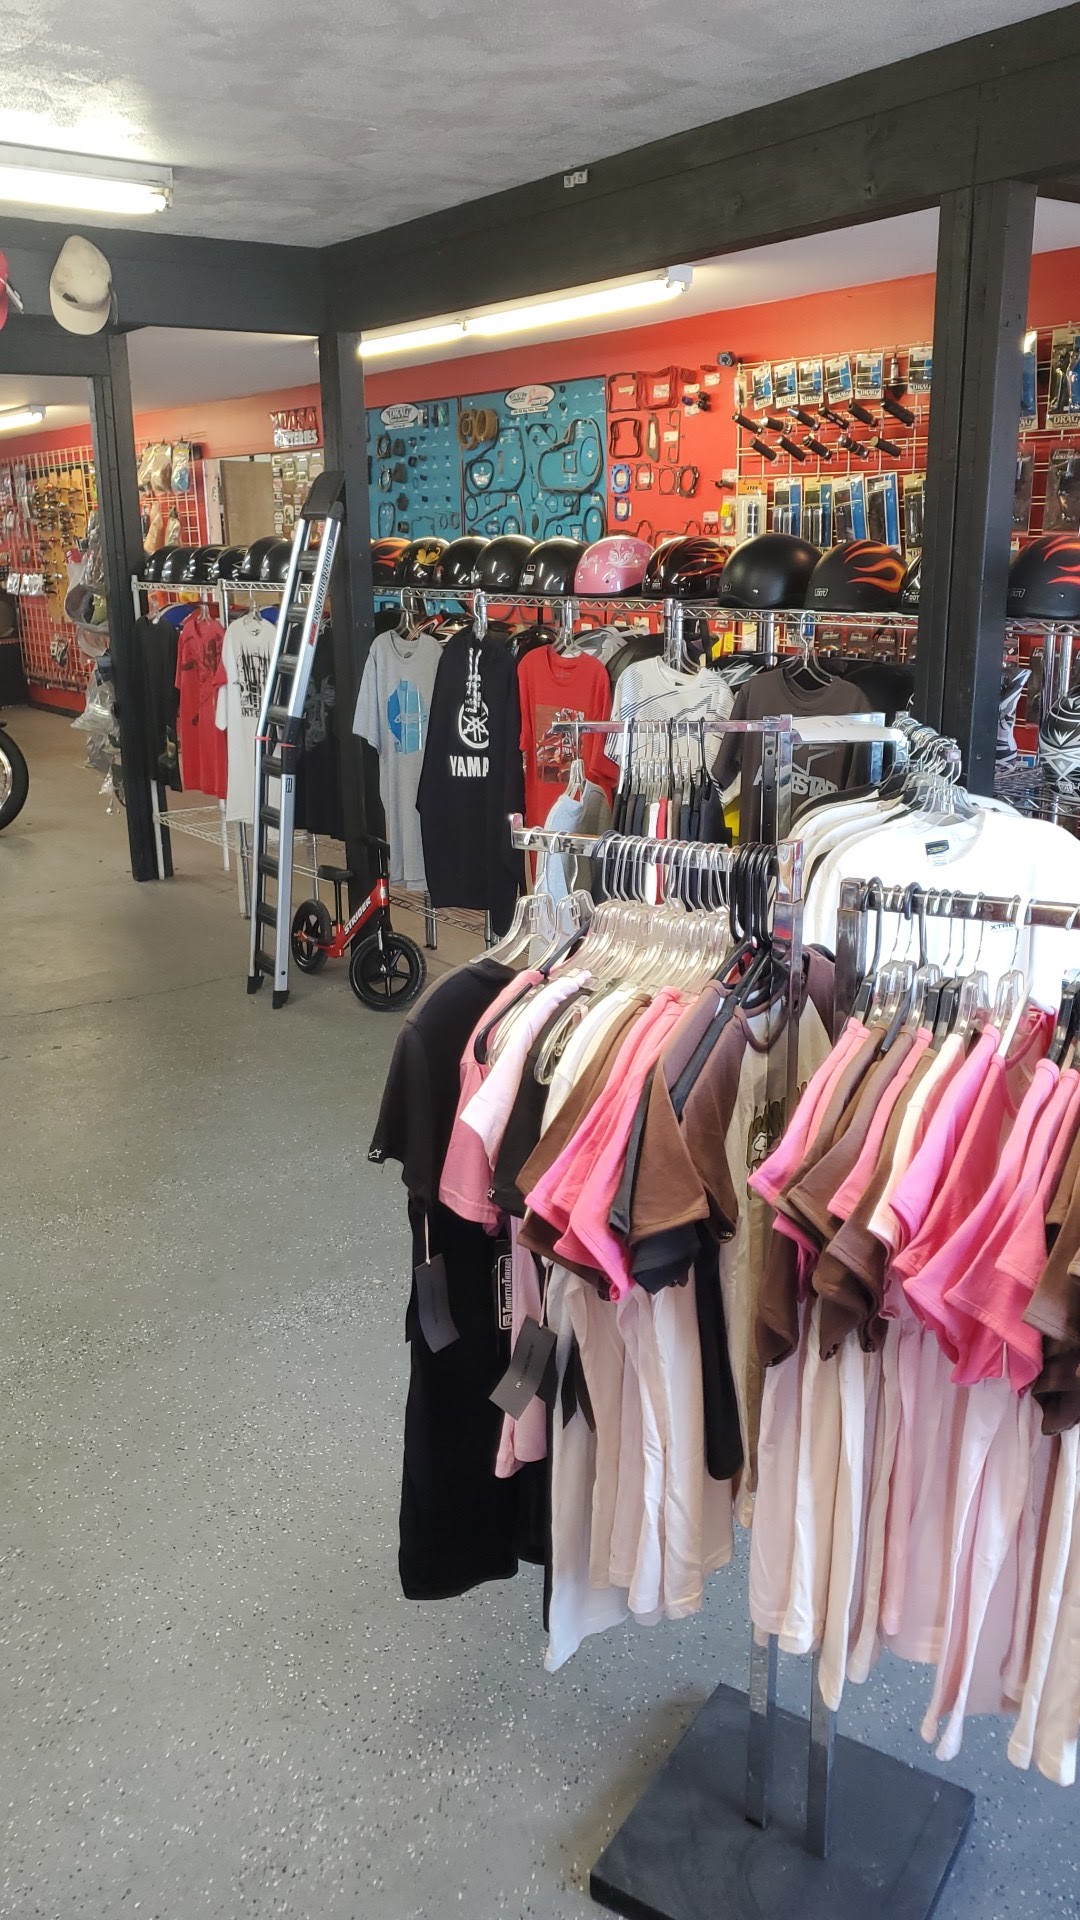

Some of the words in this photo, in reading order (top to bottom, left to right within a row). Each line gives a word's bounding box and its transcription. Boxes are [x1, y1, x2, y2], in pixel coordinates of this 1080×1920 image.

[389, 405, 409, 420] DRAG
[1053, 414, 1079, 425] DRAG
[449, 755, 490, 777] YAMA
[344, 895, 372, 936] STRIDER
